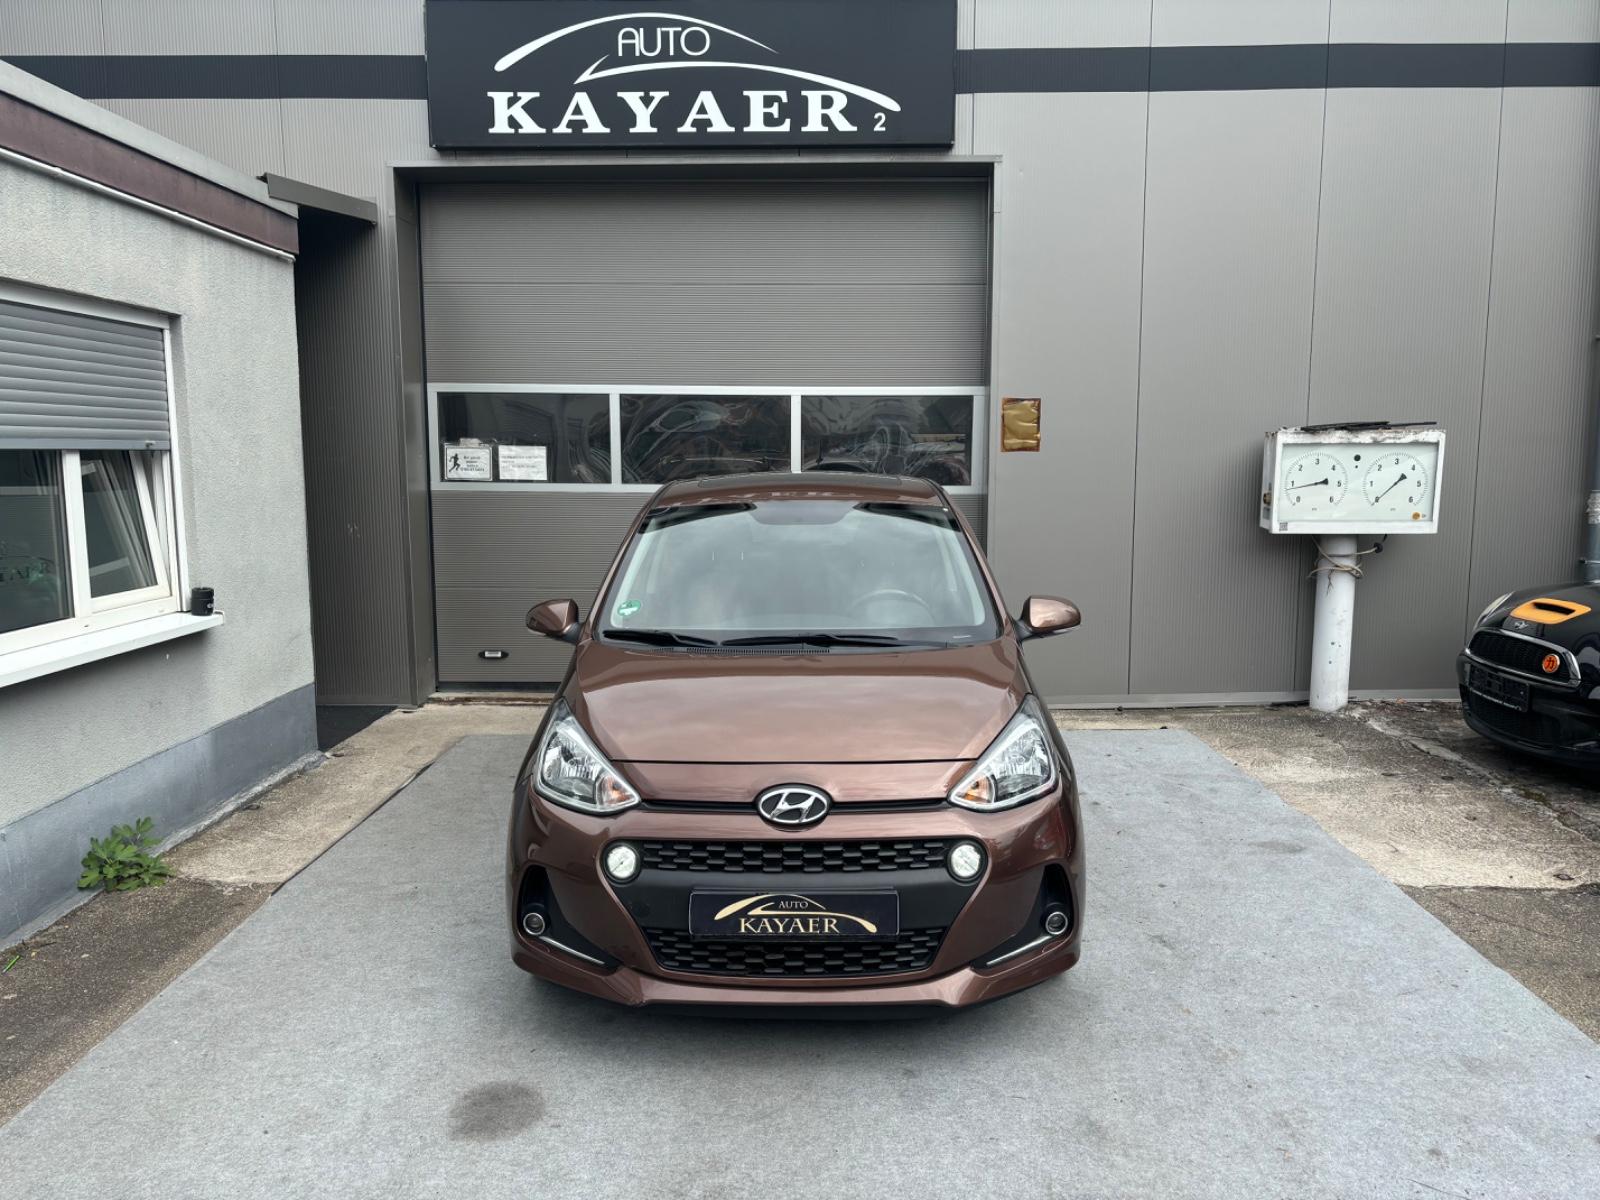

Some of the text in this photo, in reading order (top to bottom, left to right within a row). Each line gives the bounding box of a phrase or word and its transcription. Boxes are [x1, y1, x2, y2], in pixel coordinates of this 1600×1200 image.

[617, 26, 710, 57] AUTO
[487, 90, 857, 134] KAYAER
[873, 112, 886, 132] 2
[779, 901, 809, 909] AUTO
[739, 917, 840, 934] KAYAER
